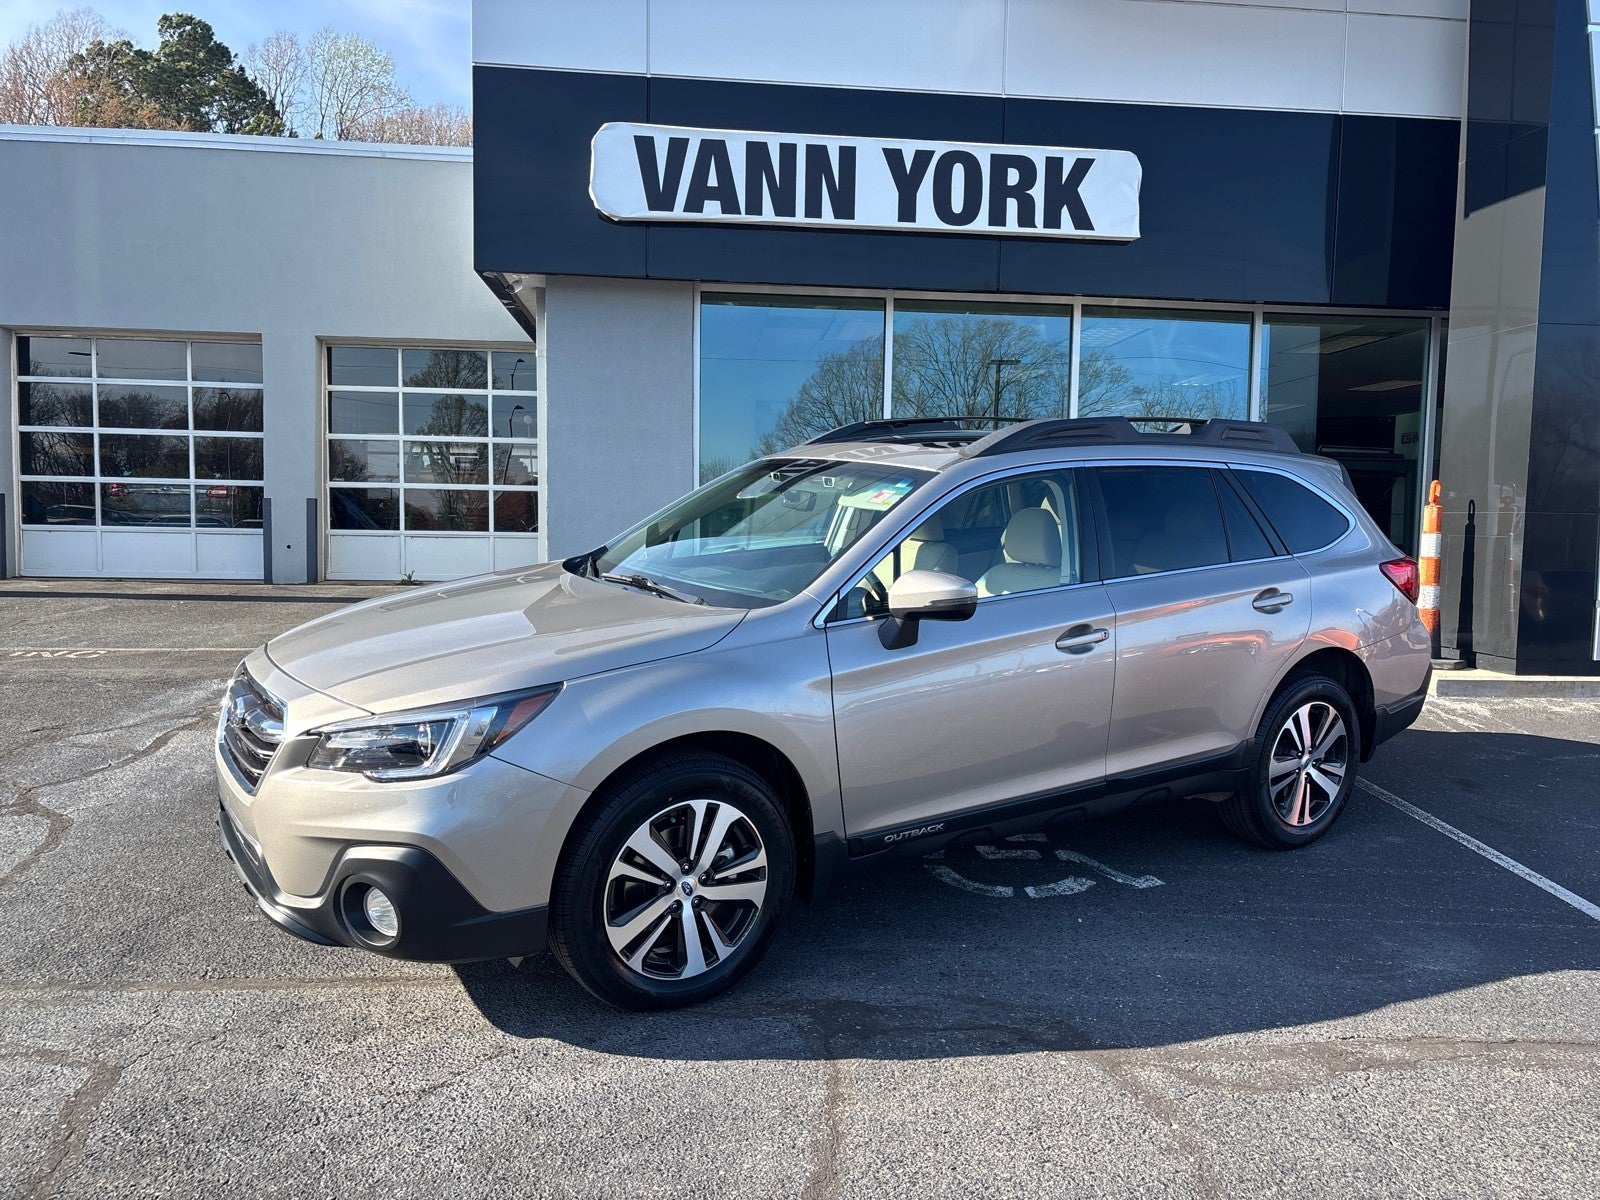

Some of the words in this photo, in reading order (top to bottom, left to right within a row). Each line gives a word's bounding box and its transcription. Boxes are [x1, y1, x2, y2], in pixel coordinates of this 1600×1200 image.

[633, 135, 857, 221] VANN
[881, 147, 1096, 231] YORK
[884, 822, 945, 843] OUTBACK
